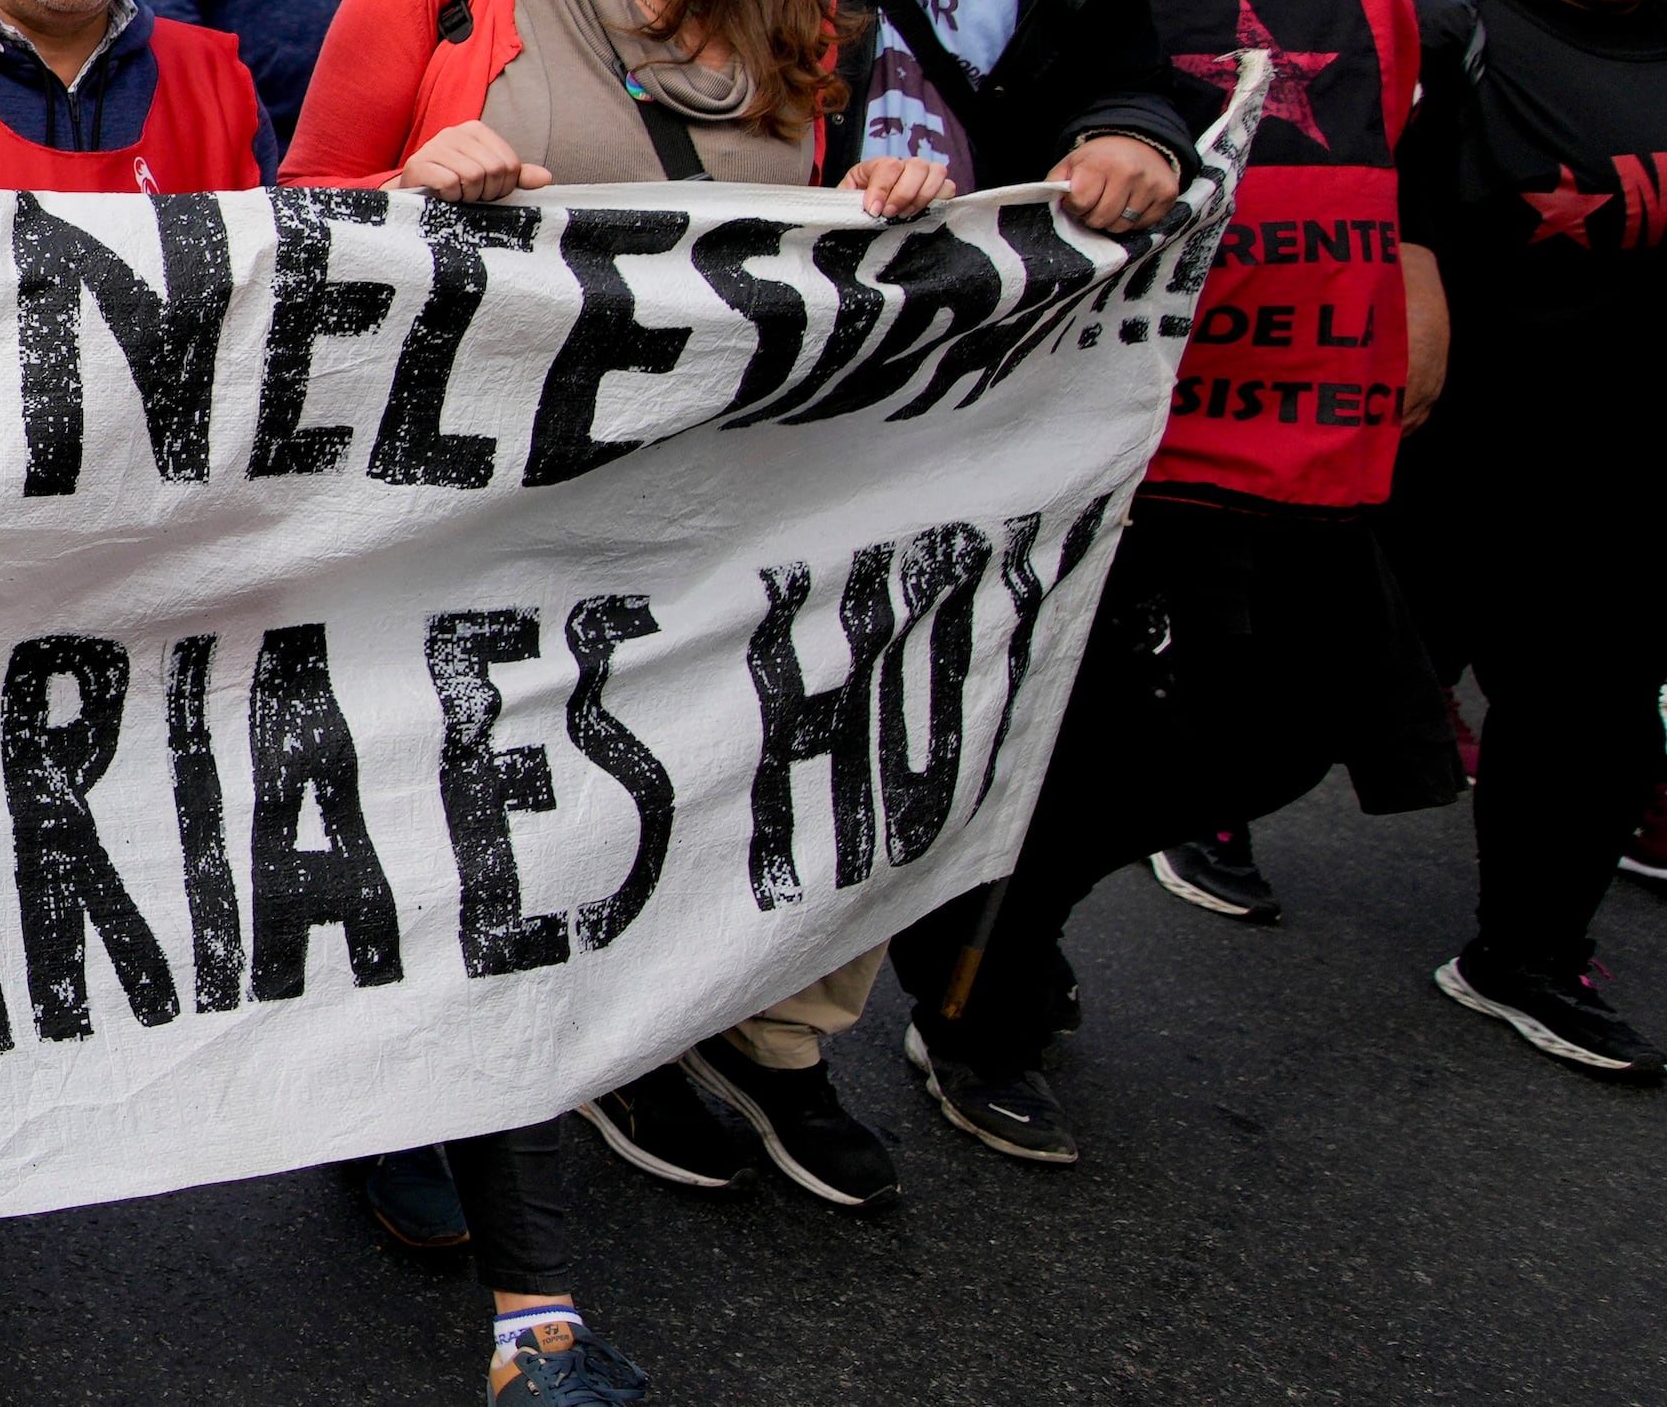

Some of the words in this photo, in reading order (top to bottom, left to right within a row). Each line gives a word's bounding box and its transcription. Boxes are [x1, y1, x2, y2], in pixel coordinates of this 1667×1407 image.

[1212, 219, 1398, 268] RENTE
[1192, 304, 1296, 348] DE
[424, 594, 675, 980] ES
